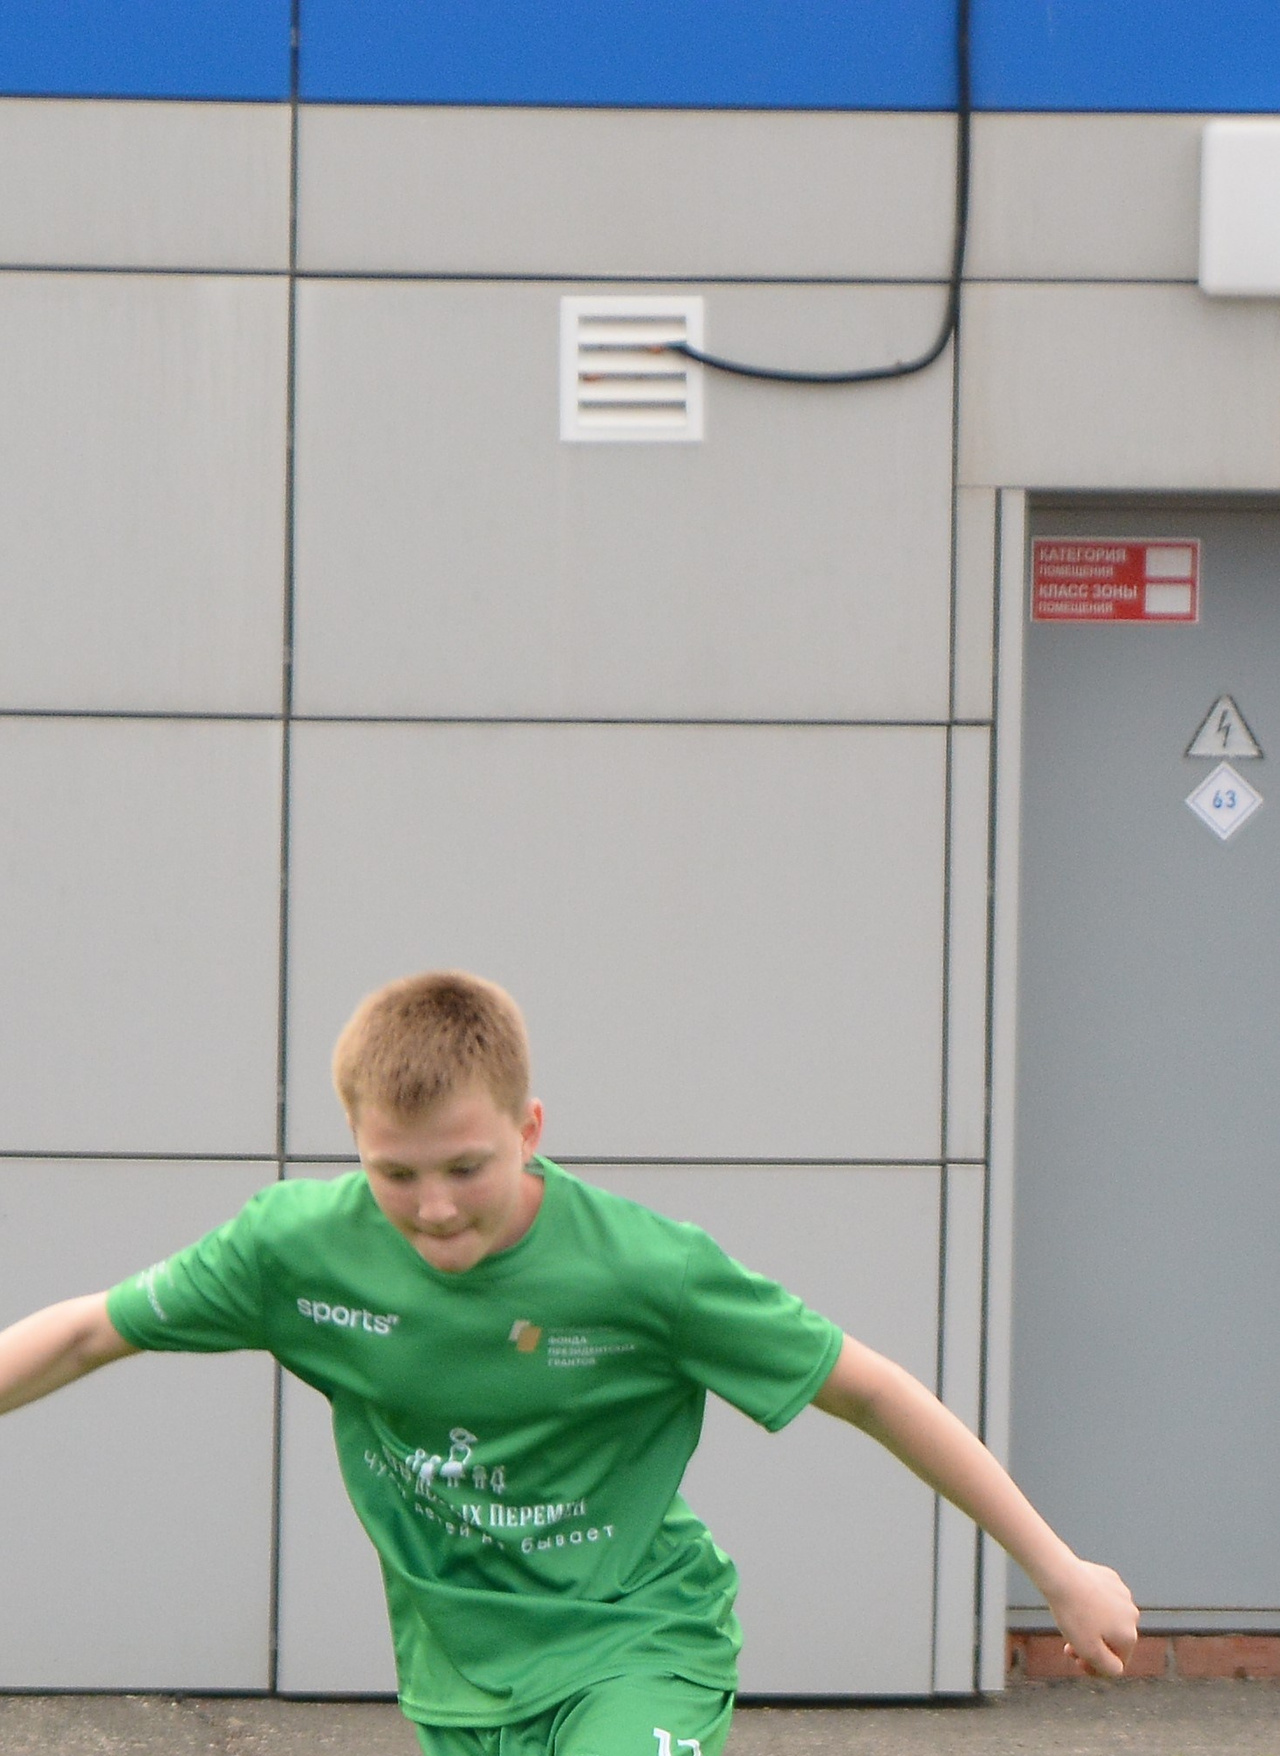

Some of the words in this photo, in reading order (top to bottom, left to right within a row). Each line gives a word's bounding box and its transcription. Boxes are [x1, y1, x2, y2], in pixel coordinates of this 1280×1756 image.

[1040, 583, 1088, 599] КЛАСС
[1092, 584, 1138, 599] ЗОНЫ
[1212, 790, 1237, 809] 63
[521, 1525, 614, 1553] бывает
